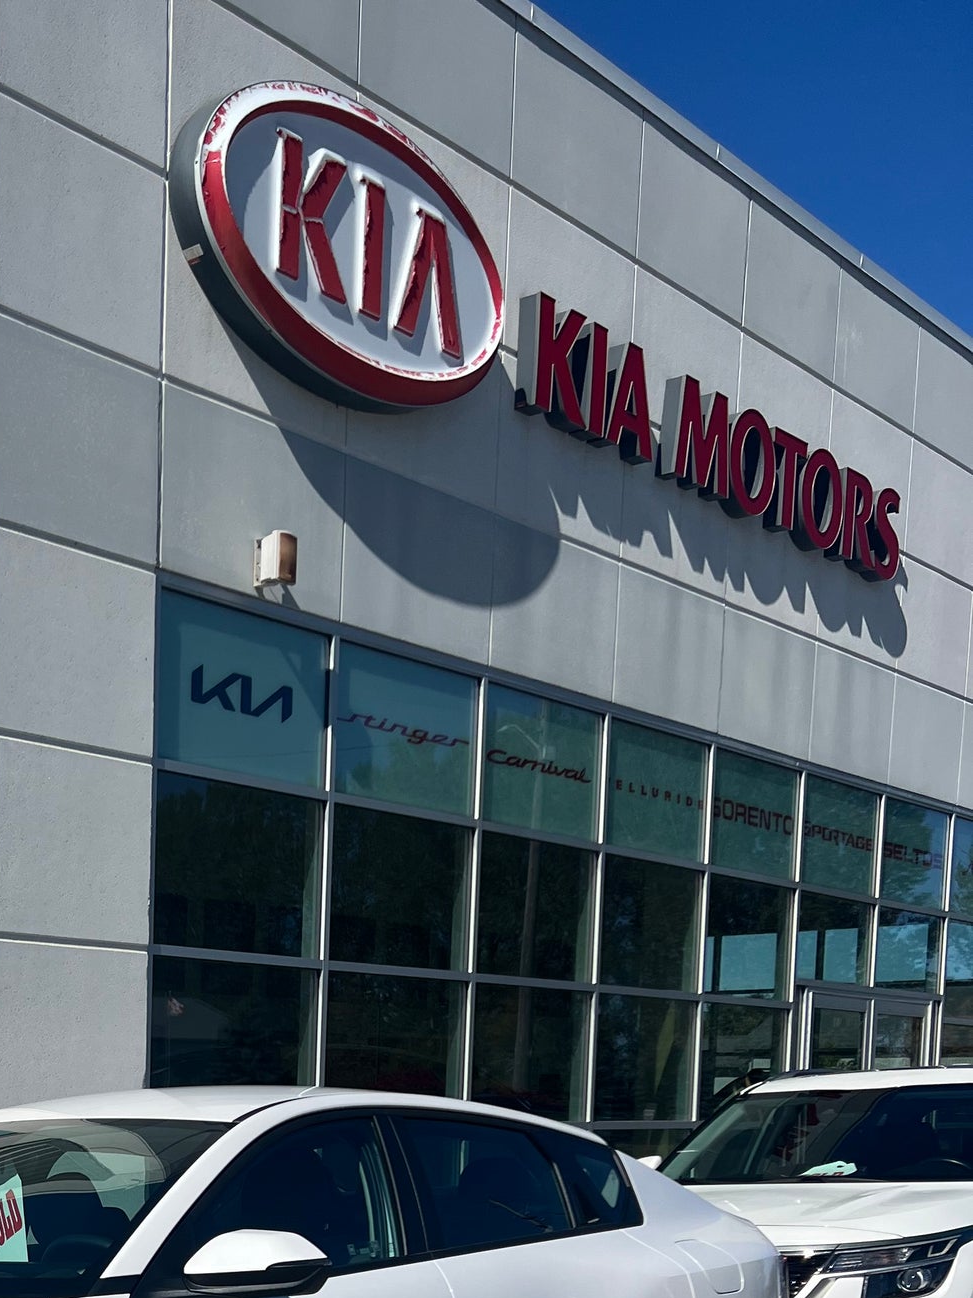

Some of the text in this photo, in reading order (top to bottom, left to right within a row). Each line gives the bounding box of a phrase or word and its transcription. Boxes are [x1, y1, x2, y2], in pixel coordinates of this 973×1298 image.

[275, 127, 461, 360] KIA
[533, 291, 901, 581] KIA MOTORS
[191, 664, 294, 723] KIA
[486, 749, 592, 785] Carnival
